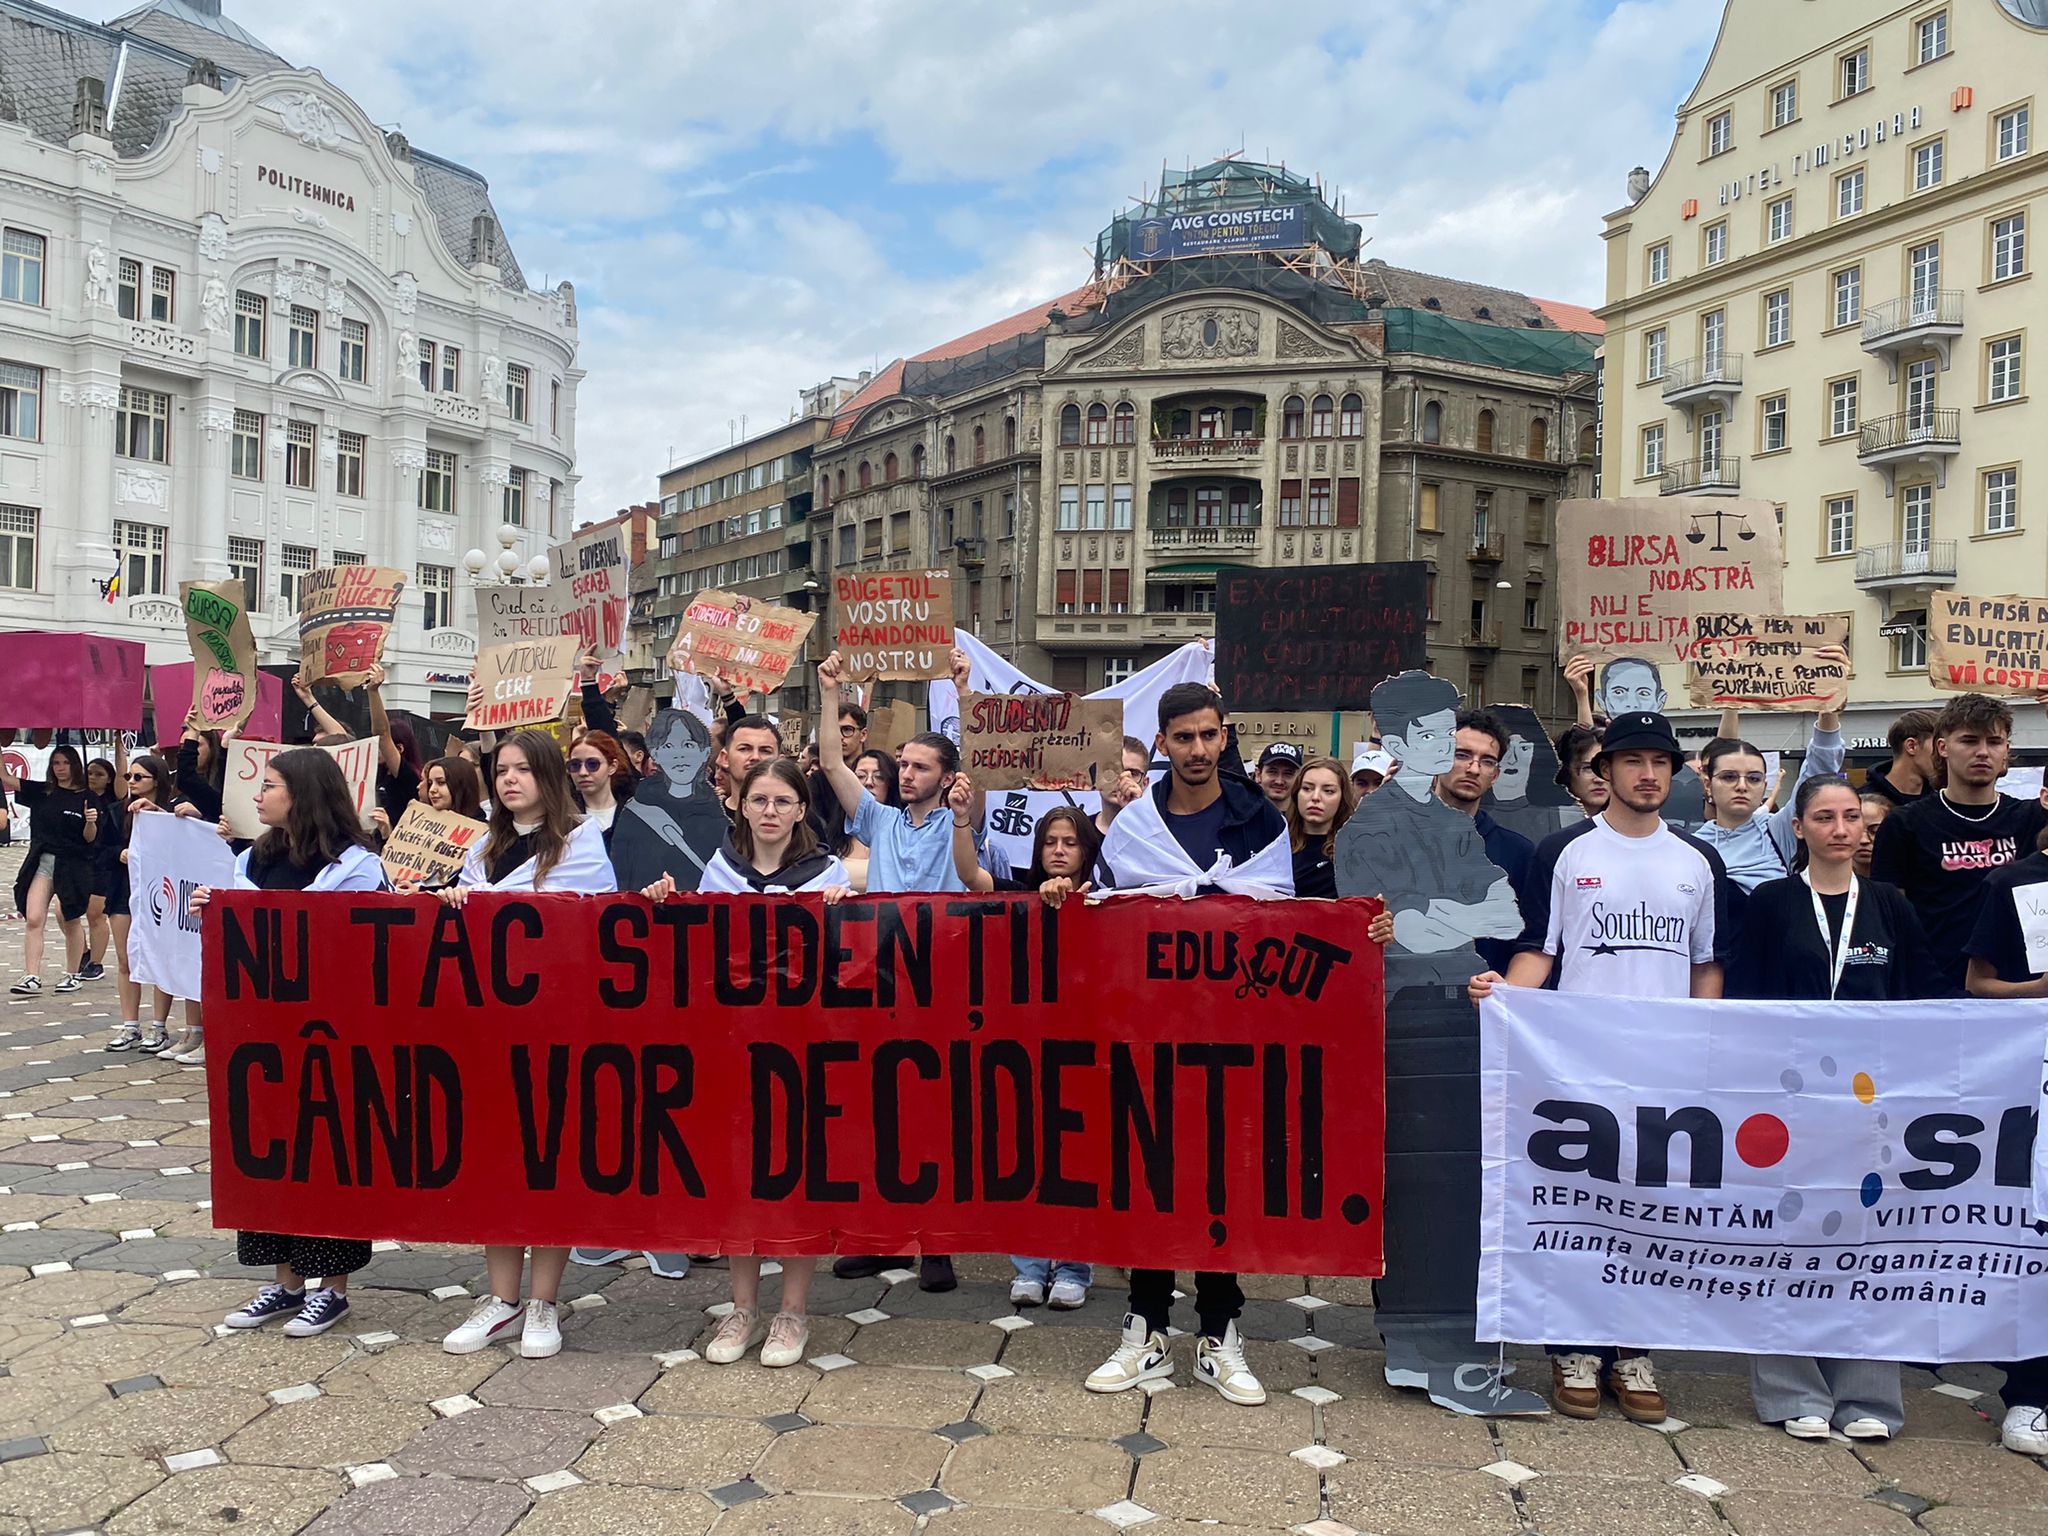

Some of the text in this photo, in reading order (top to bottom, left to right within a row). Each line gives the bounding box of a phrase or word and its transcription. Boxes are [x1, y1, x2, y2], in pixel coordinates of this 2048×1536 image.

[258, 165, 354, 212] POLITEHNICA
[1719, 164, 1782, 206] HOTEL
[1171, 207, 1294, 231] AVG CONSTECH
[1211, 225, 1245, 239] PENTRU
[1249, 222, 1281, 235] TRECUT
[1595, 369, 1604, 456] HOTEL
[1588, 535, 1680, 567] BURSA
[342, 566, 377, 586] NU
[837, 575, 940, 602] BUGETUL
[1650, 561, 1754, 592] NOASTRĂ
[188, 591, 233, 631] BURSA
[491, 590, 526, 615] Cred
[530, 598, 546, 614] că
[846, 599, 930, 625] VOSTRU
[1590, 594, 1654, 617] NU E
[1947, 596, 1971, 616] VĂ
[1979, 600, 2030, 622] PASĂ
[747, 617, 761, 633] O
[837, 624, 953, 647] ABANDONUL
[1696, 615, 1753, 640] BURSA
[1805, 620, 1826, 635] NU
[1947, 623, 2048, 651] EDUCAȚI
[678, 631, 692, 650] A
[1700, 640, 1802, 659] E PENTRU
[850, 650, 934, 672] NOSTRU
[1985, 648, 2041, 670] PÂNĂ
[1775, 667, 1784, 680] E
[1792, 665, 1844, 680] PENTRU
[1947, 660, 1977, 685] VĂ
[494, 675, 534, 700] CERE
[1237, 720, 1317, 735] ODERN
[1850, 738, 1891, 749] STARB
[448, 824, 475, 846] NU
[1997, 836, 2017, 852] IN
[434, 841, 469, 860] BUGET
[1591, 901, 1685, 943] Southern
[222, 905, 310, 1002] NU
[350, 902, 543, 1007] TAC
[598, 900, 1059, 1032] STUDENȚII
[227, 1019, 1370, 1248] CÂND VOR DECIDENȚII.
[1531, 1184, 2034, 1229] REPREZENTĂM VIITORUL
[1532, 1230, 2048, 1278] Alianța Națională a Organizațiilo
[1601, 1263, 1987, 1306] Studențești din România
